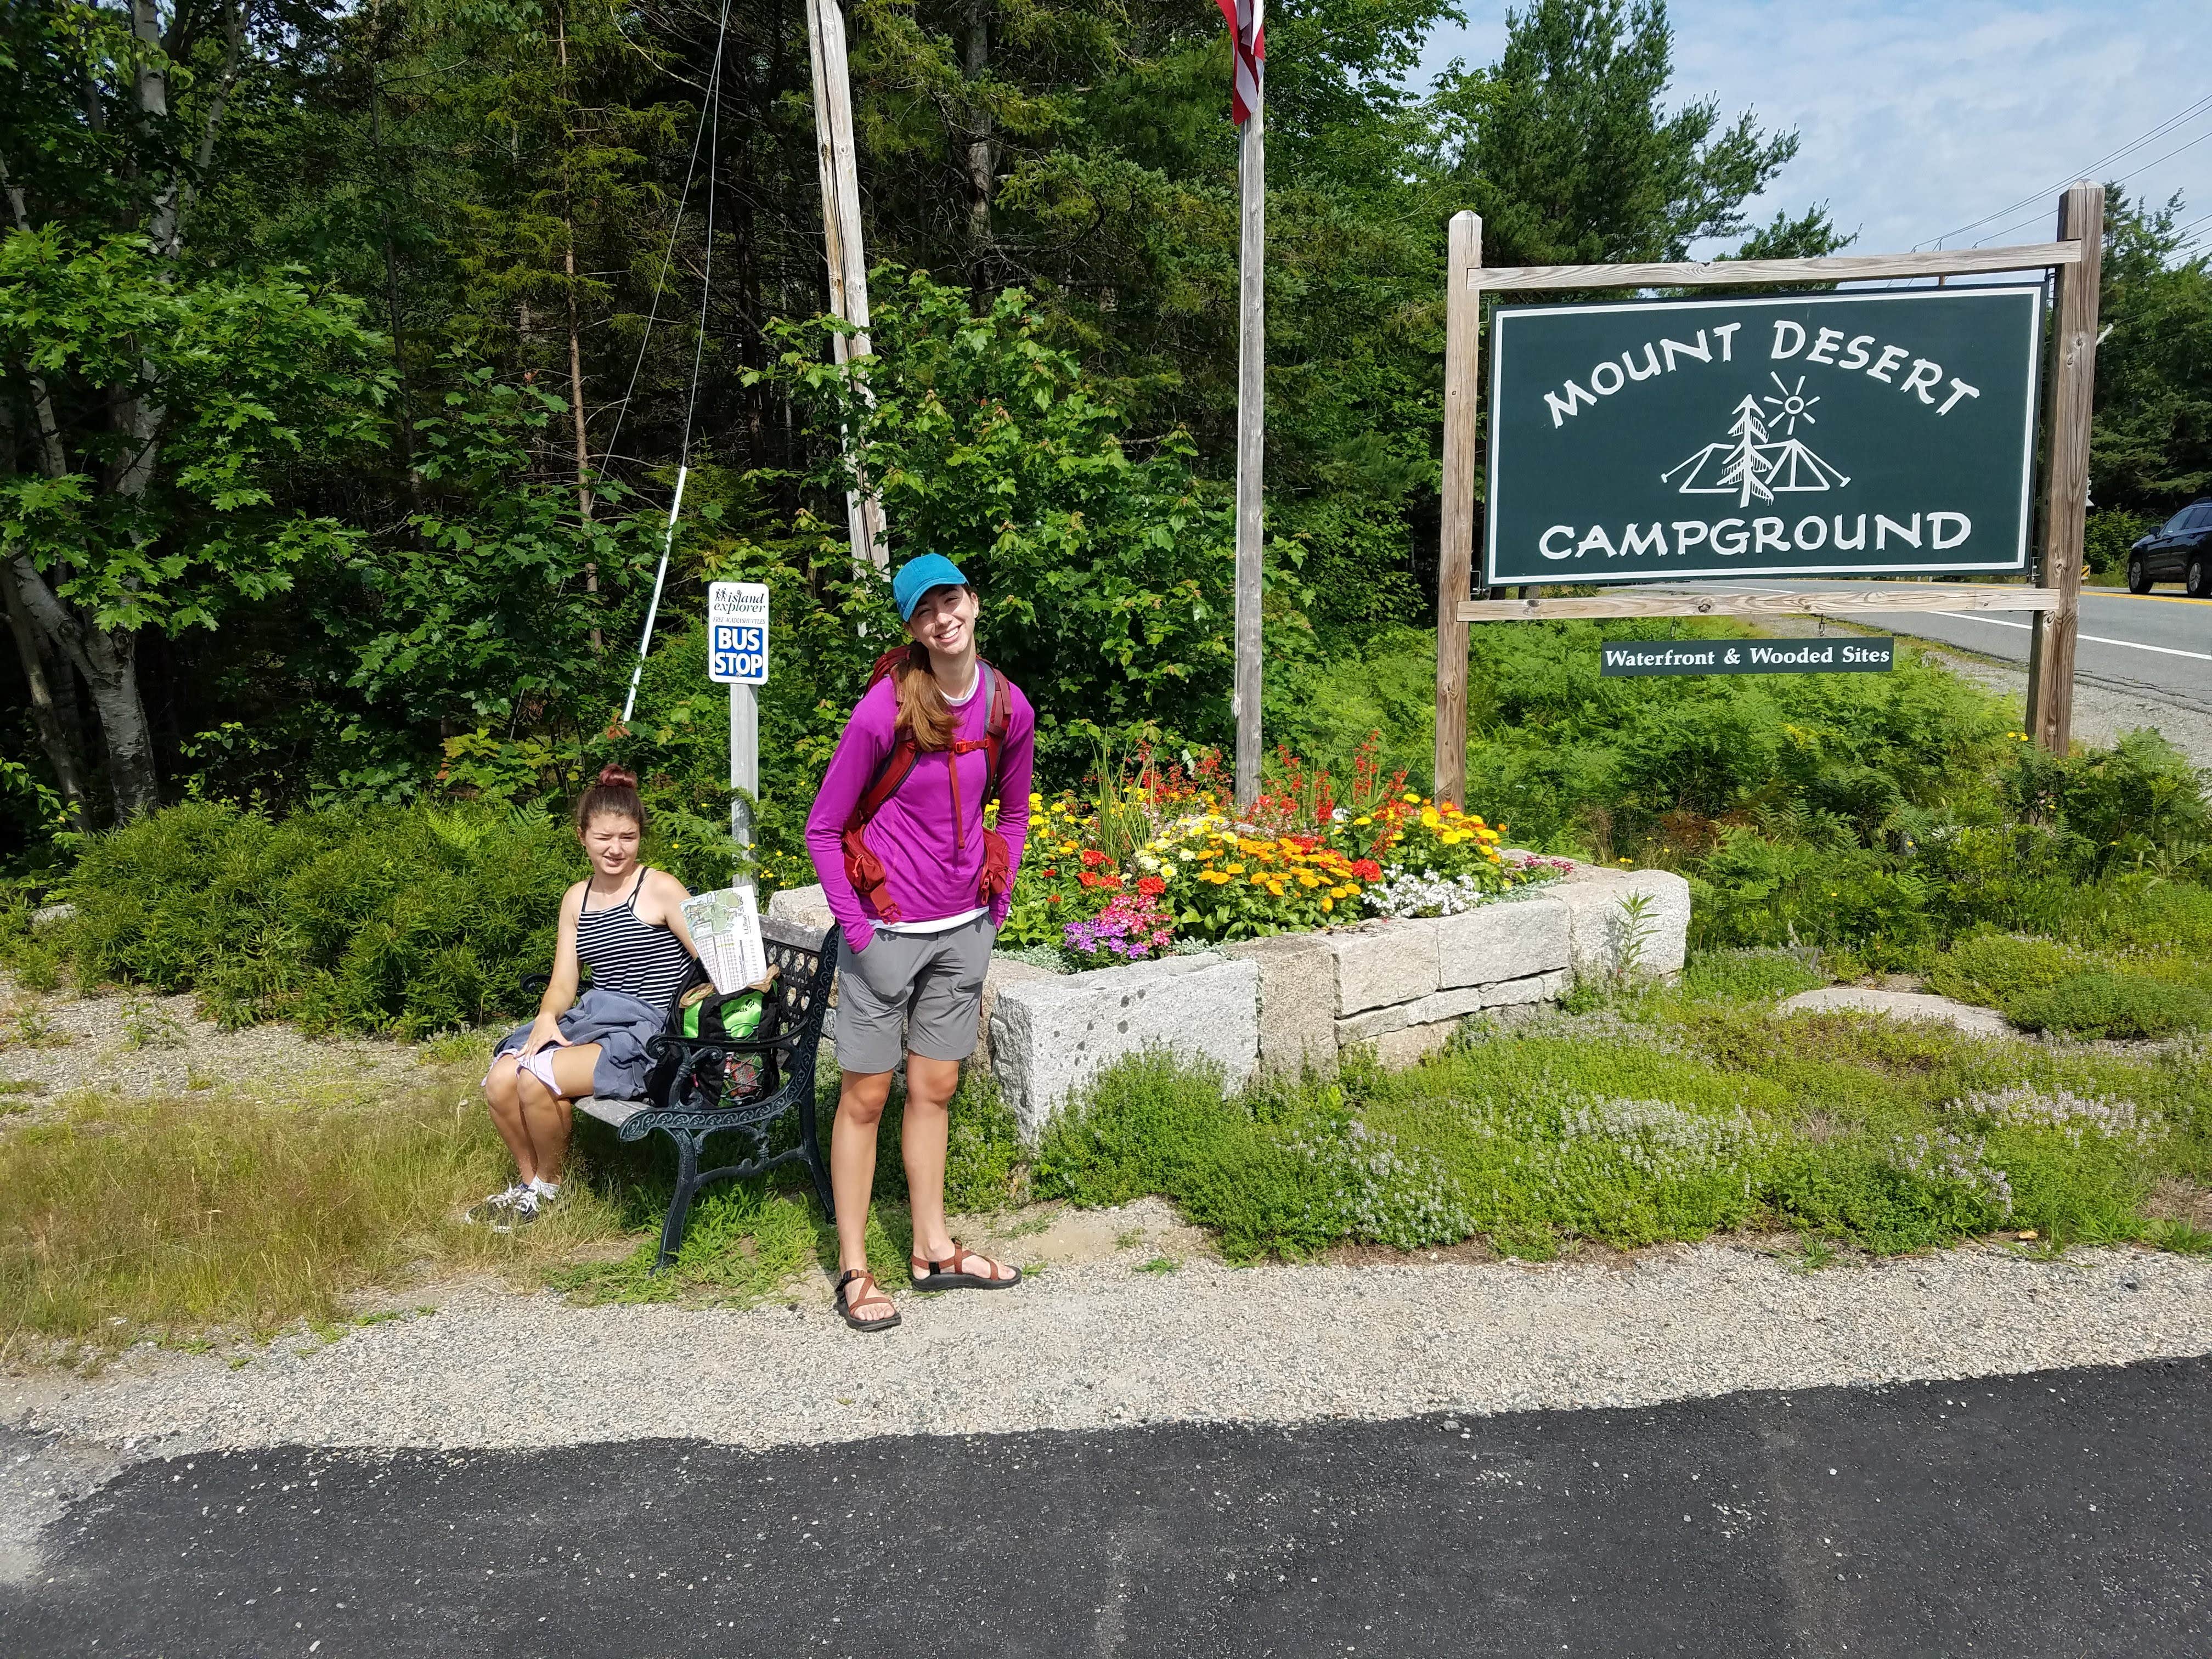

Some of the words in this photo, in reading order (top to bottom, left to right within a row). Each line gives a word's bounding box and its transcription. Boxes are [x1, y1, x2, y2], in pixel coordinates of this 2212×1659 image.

[1543, 322, 1741, 429] MOUNT
[1770, 320, 1980, 416] DESERT
[1539, 511, 1972, 560] CAMPGROUND
[714, 603, 765, 614] explorer
[728, 592, 764, 603] island
[718, 628, 760, 651] BUS
[715, 652, 763, 675] STOP
[1605, 649, 1716, 667] Waterfront
[1724, 648, 1741, 664] &
[1750, 646, 1833, 664] Wooded
[1842, 646, 1889, 663] Sites
